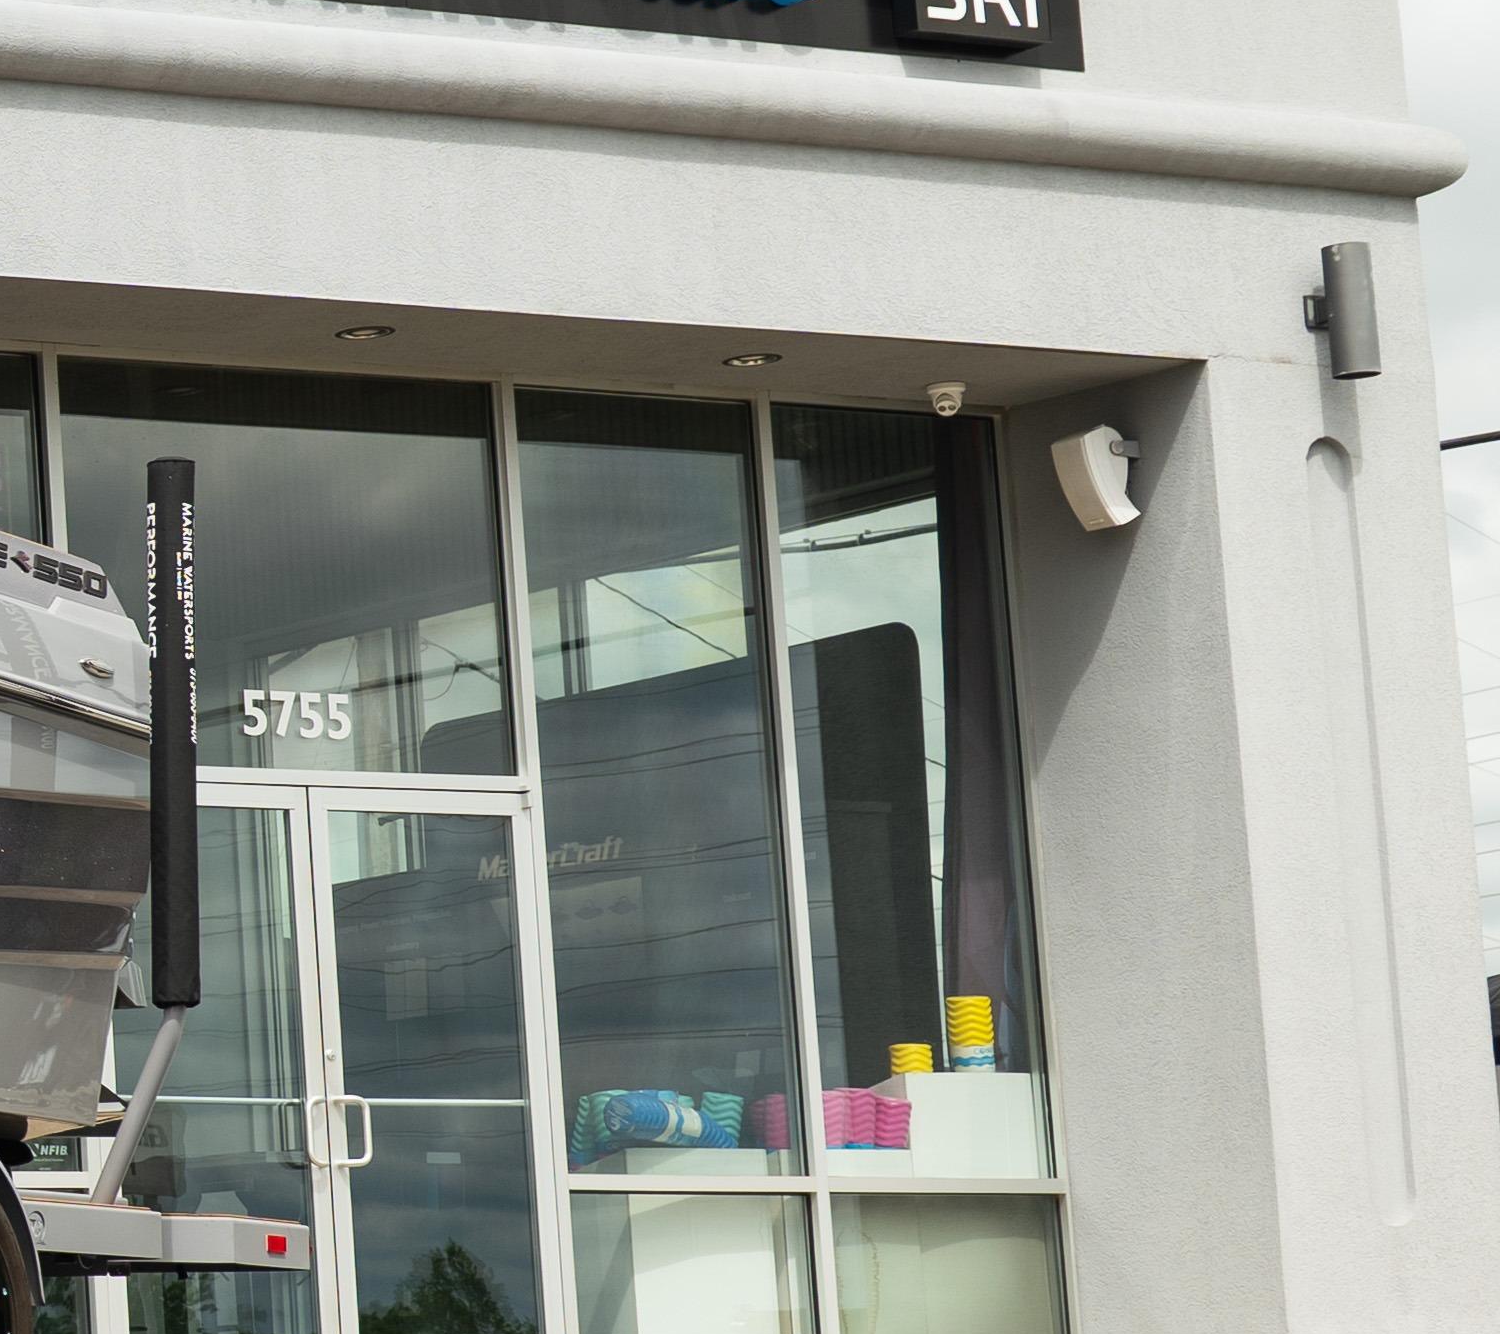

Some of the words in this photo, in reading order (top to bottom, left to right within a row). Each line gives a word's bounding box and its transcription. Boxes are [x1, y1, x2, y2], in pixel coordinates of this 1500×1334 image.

[181, 502, 194, 562] MARINE
[31, 553, 108, 600] 550
[184, 564, 195, 661] WATERSPORTS
[243, 688, 352, 740] 5755
[40, 1144, 69, 1156] NFIB
